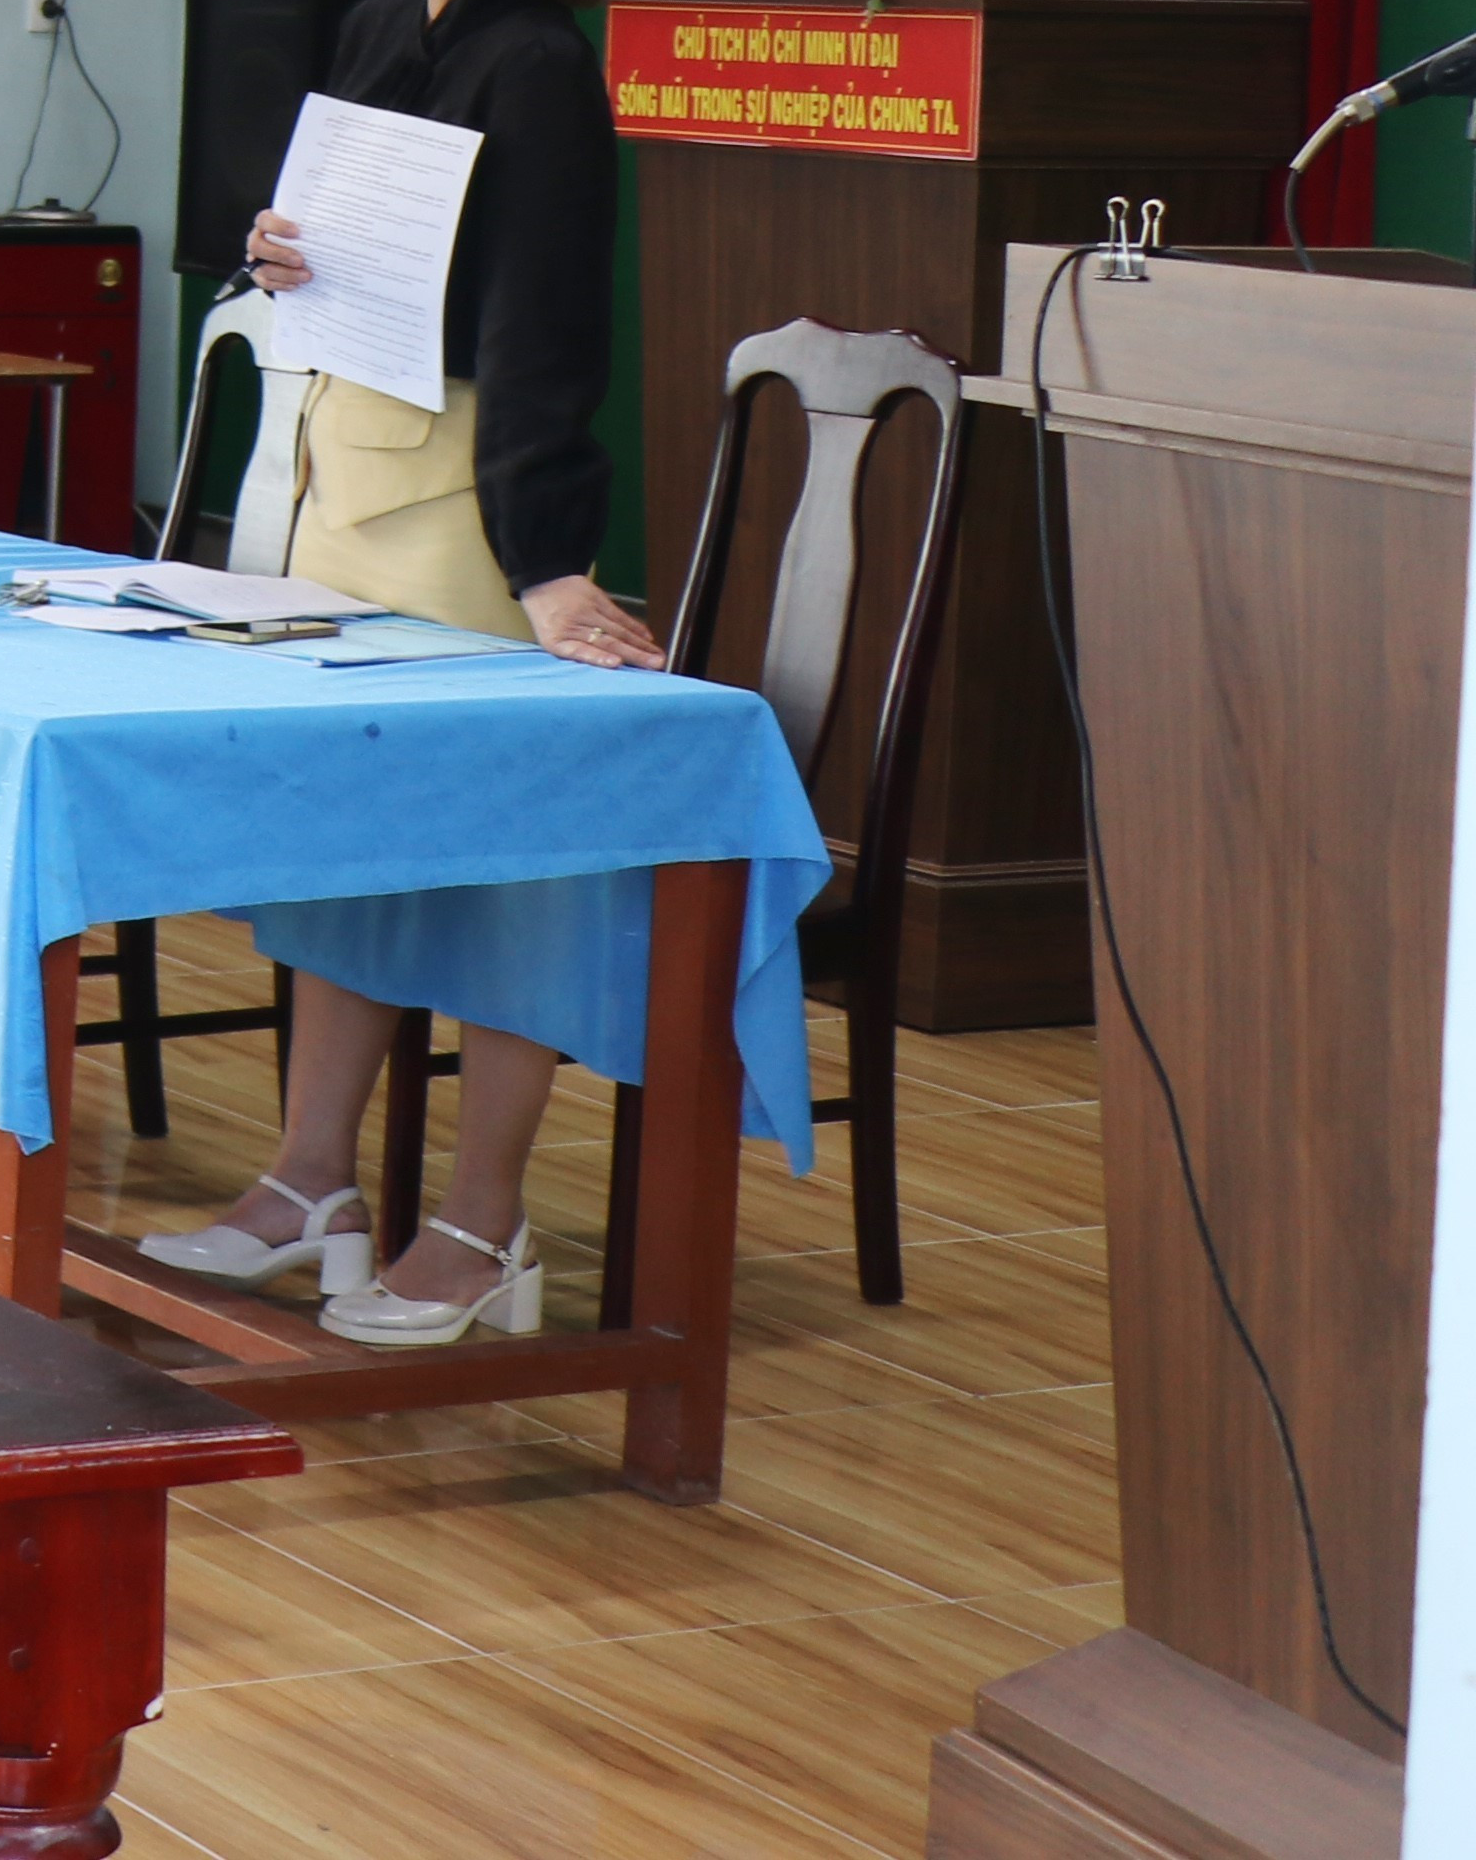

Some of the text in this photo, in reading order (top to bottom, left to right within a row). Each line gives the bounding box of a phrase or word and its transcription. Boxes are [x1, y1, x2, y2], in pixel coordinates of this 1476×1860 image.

[708, 26, 745, 71] TỊCH
[747, 13, 771, 64] HỒ
[773, 19, 802, 64] CHÍ
[803, 29, 847, 66] MINH
[869, 32, 900, 79] ĐẠI
[617, 69, 658, 118] SỐNG
[691, 86, 743, 122] TRONG
[745, 83, 770, 134] SỰ
[770, 84, 831, 137] NGHIỆP
[832, 81, 867, 130] CỦA
[870, 86, 929, 134] CHÚNG
[931, 98, 960, 136] TA.
